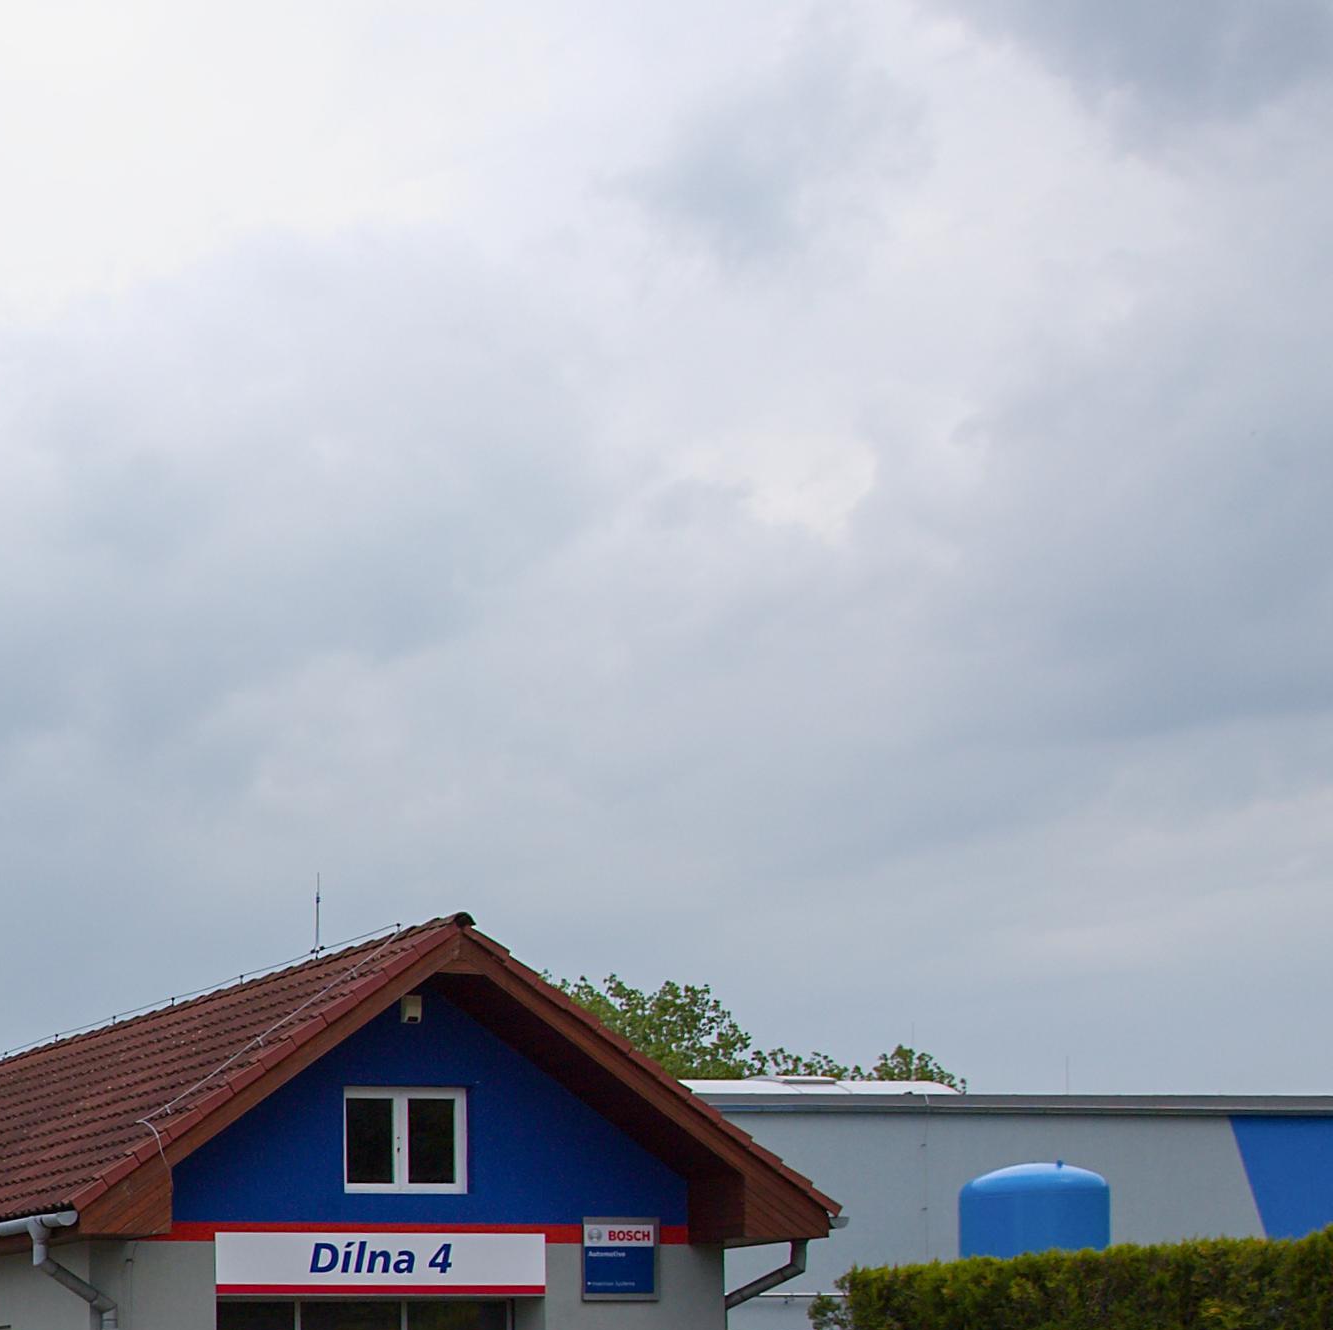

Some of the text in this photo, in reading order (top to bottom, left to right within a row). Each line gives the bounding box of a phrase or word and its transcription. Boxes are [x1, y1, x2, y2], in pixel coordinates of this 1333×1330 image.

[608, 1230, 650, 1241] BOSCH
[309, 1240, 452, 1274] Dílna 4
